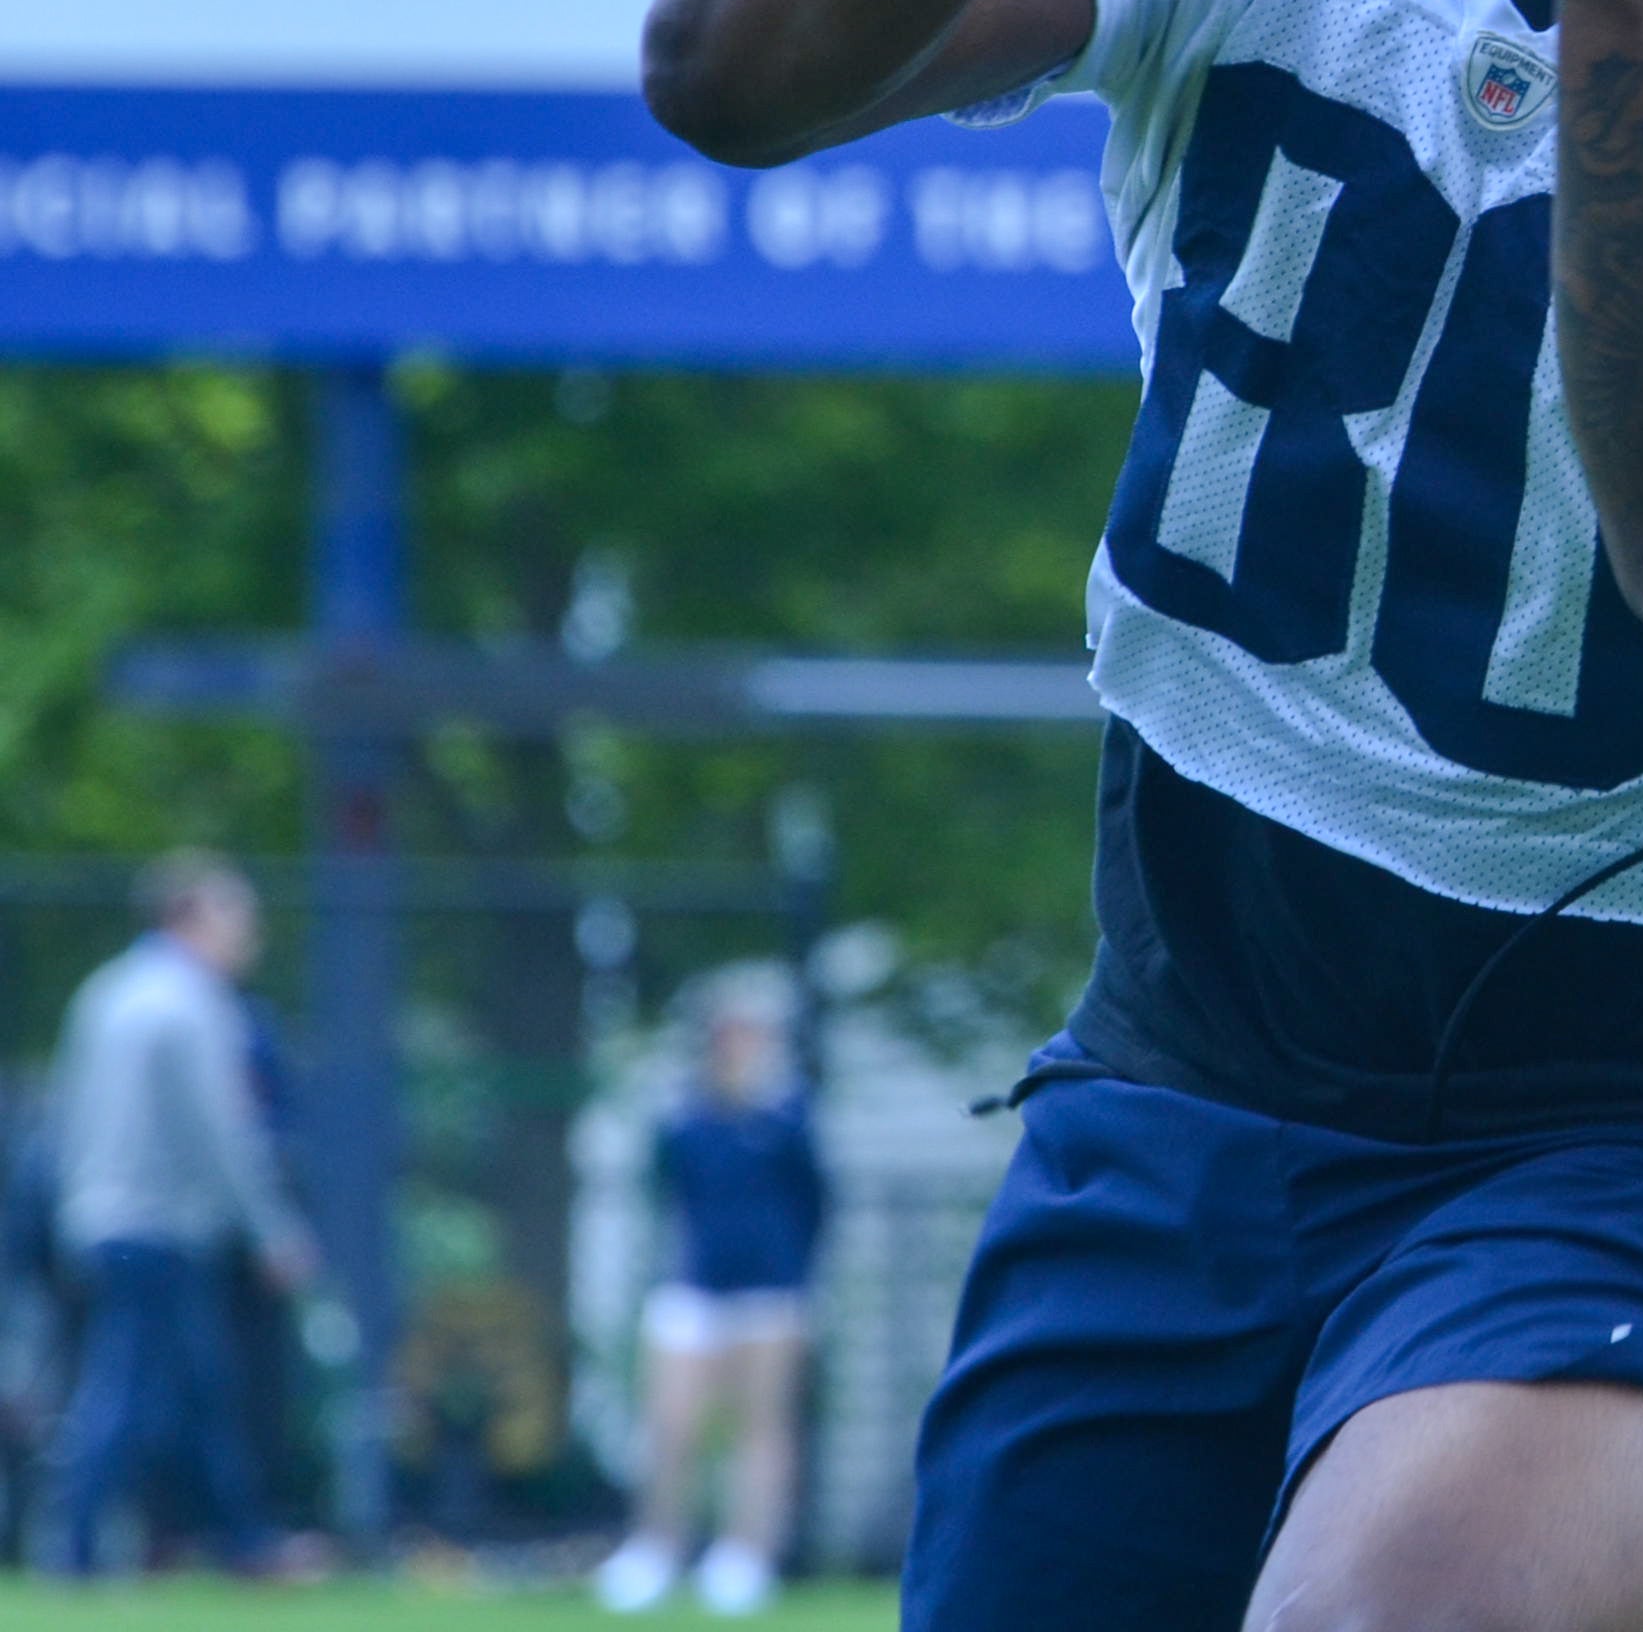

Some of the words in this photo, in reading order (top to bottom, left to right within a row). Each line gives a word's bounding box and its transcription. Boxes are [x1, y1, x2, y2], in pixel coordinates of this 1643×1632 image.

[1480, 42, 1554, 86] EQUIPMENT
[1481, 79, 1516, 114] NFL
[279, 158, 727, 266] PARTNER
[748, 165, 886, 268] OF
